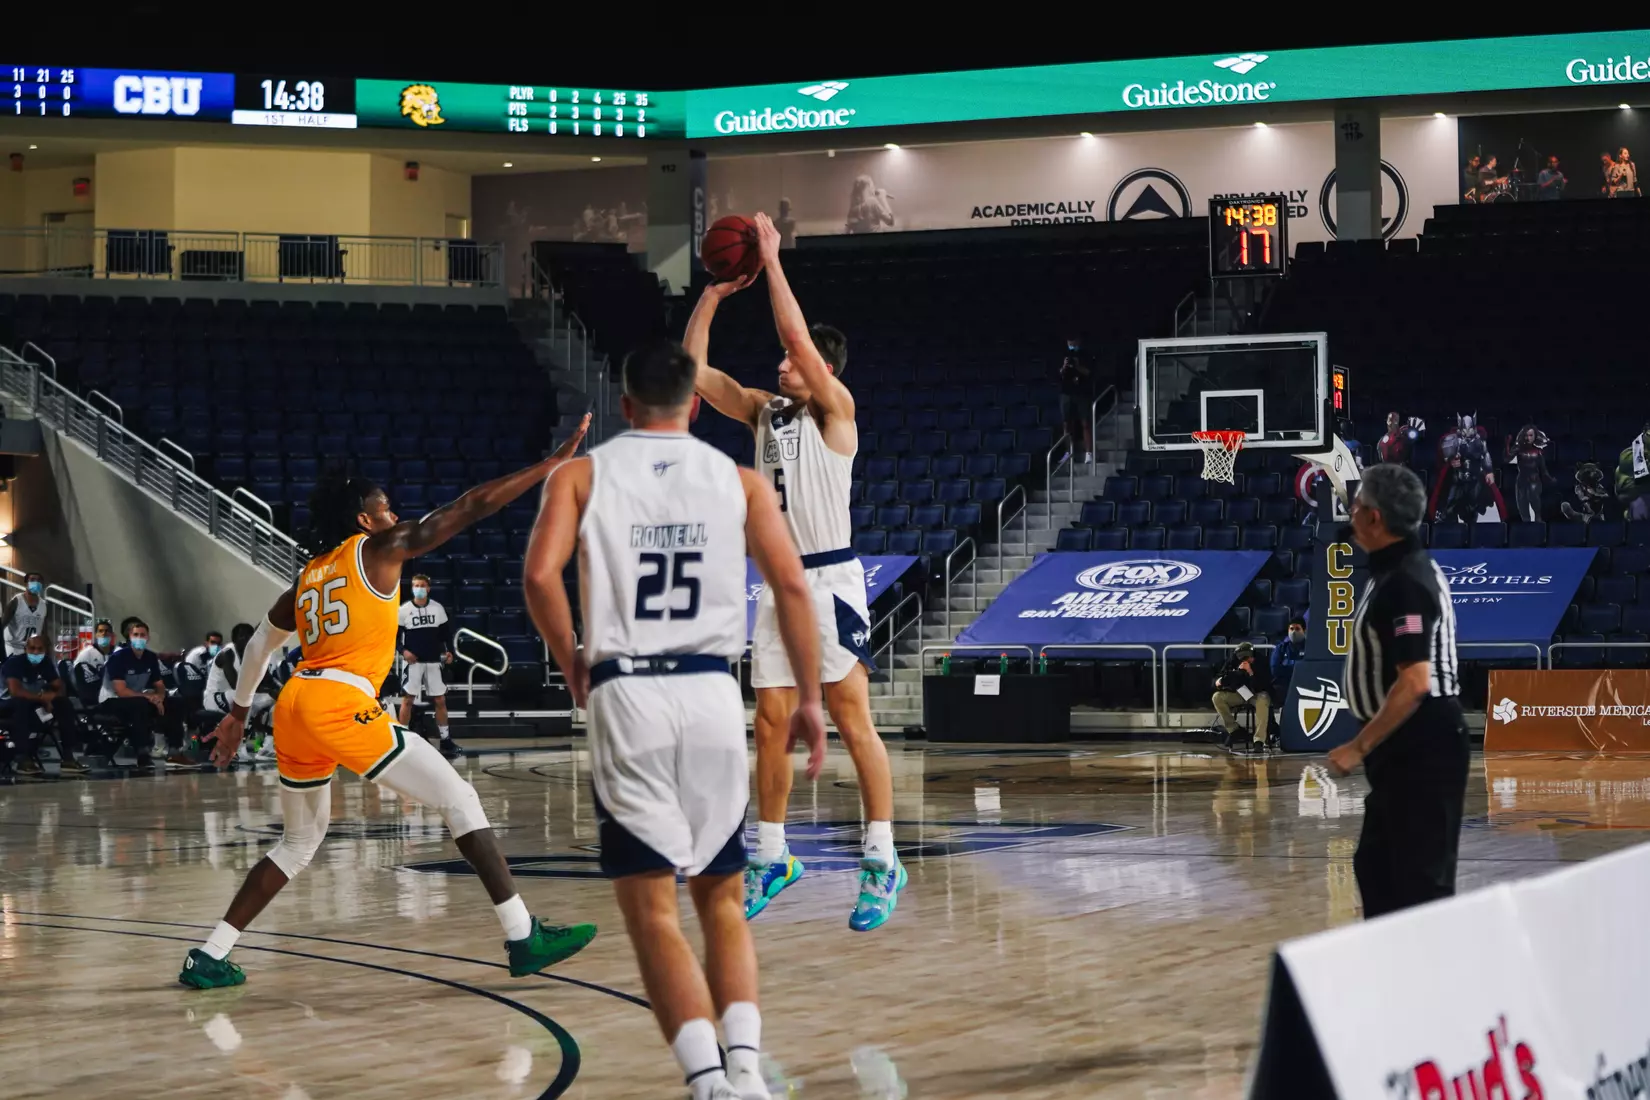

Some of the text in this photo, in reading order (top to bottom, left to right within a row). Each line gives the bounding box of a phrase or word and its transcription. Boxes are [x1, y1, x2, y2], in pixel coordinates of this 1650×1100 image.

[12, 67, 74, 84] 11 21 25
[1565, 55, 1650, 83] Guide
[13, 83, 71, 100] 3 0 0
[113, 75, 203, 116] CBU
[260, 79, 325, 112] 14:38
[509, 86, 648, 107] PLYR 0 2 4 25 35
[14, 100, 71, 117] 1 1 0
[508, 102, 646, 122] PTS 2 3 0 3 2
[264, 115, 285, 125] 1ST
[508, 118, 646, 138] FLS 0 1 0 0 0
[970, 200, 1096, 219] ACADEMICALLY
[1225, 203, 1277, 227] 14:38
[1240, 228, 1271, 265] 17
[630, 523, 708, 548] ROWELL
[1104, 565, 1177, 579] FOX
[1448, 575, 1553, 585] HOTELS
[634, 552, 703, 620] 25
[297, 575, 350, 646] 35
[1017, 608, 1190, 619] SAN BERNARDINO
[1057, 602, 1163, 612] RIVERSIDE
[412, 614, 436, 627] CBU
[1521, 705, 1596, 717] RIVERSIDE
